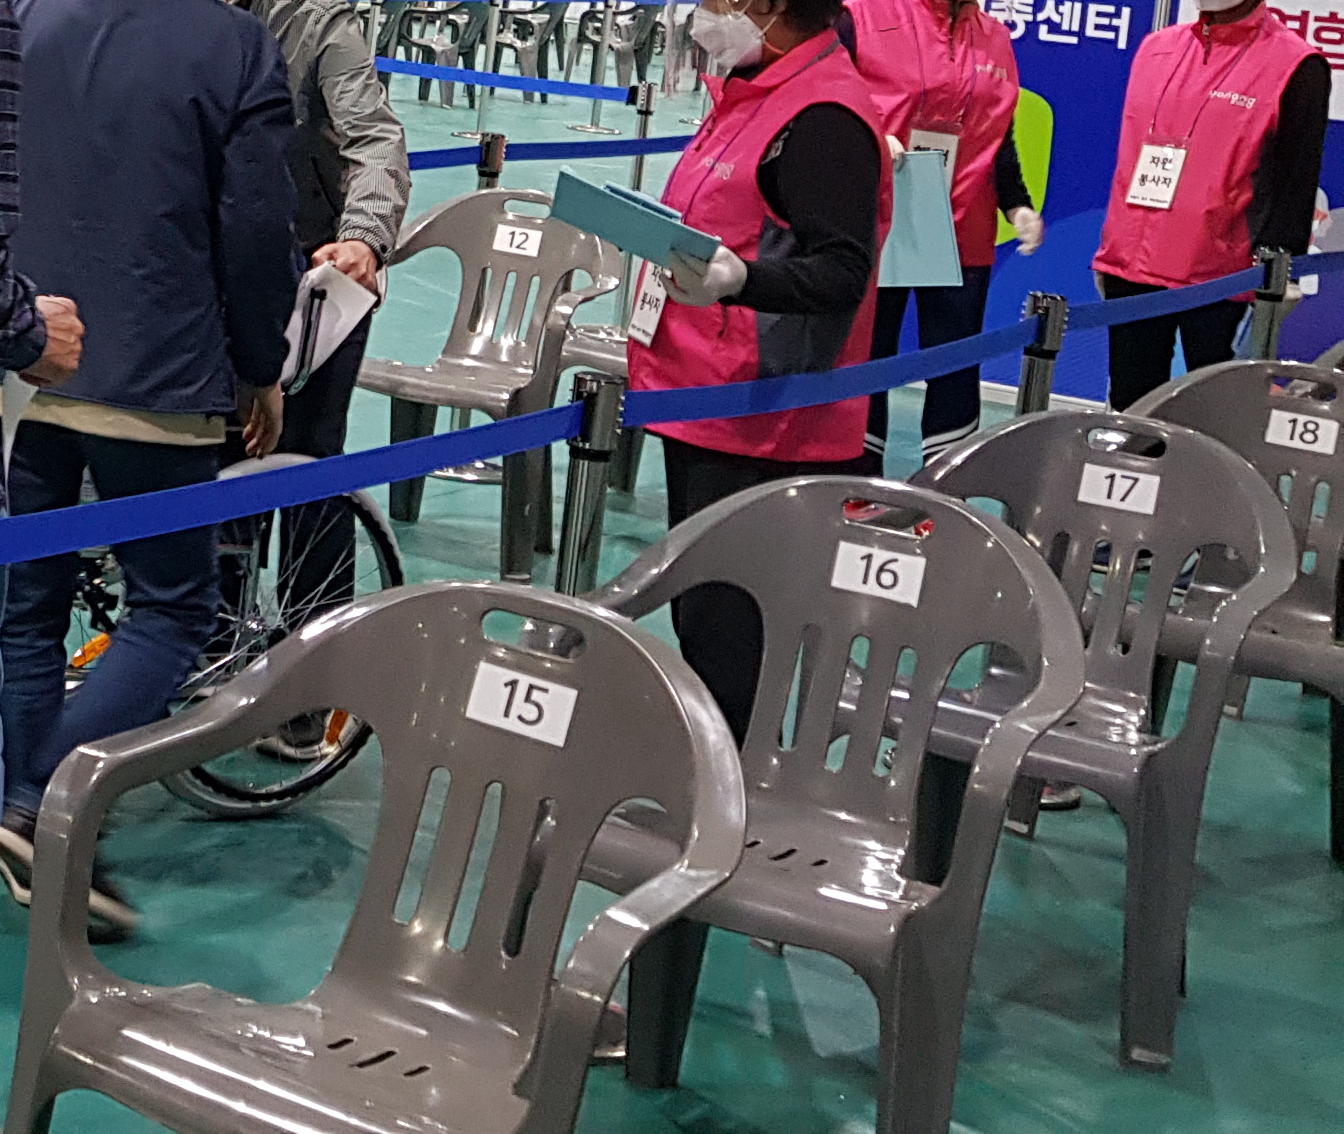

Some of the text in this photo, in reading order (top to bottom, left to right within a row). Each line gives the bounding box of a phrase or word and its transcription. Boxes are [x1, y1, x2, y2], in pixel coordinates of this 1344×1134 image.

[508, 230, 530, 251] 12
[1287, 417, 1320, 445] 18
[1103, 472, 1140, 503] 17
[859, 552, 900, 590] 16
[503, 678, 550, 727] 15
